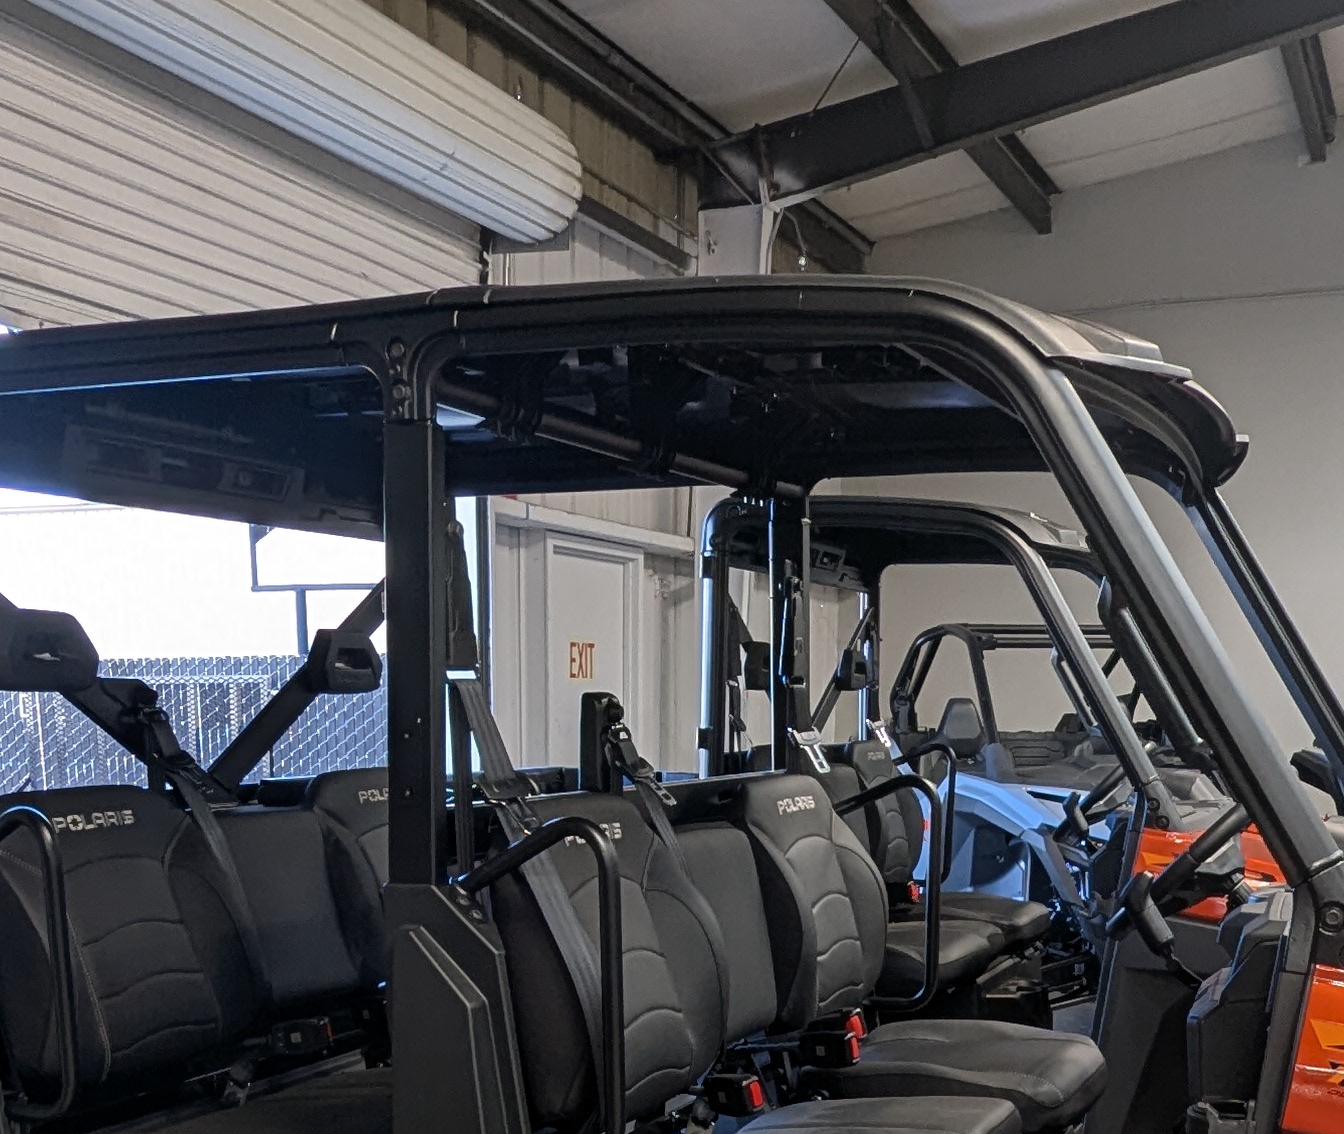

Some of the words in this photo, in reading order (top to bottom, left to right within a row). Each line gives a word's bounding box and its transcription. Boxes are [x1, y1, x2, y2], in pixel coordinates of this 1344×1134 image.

[569, 641, 596, 679] EXIT
[777, 795, 816, 815] POLARIS
[51, 809, 135, 833] POLARIS
